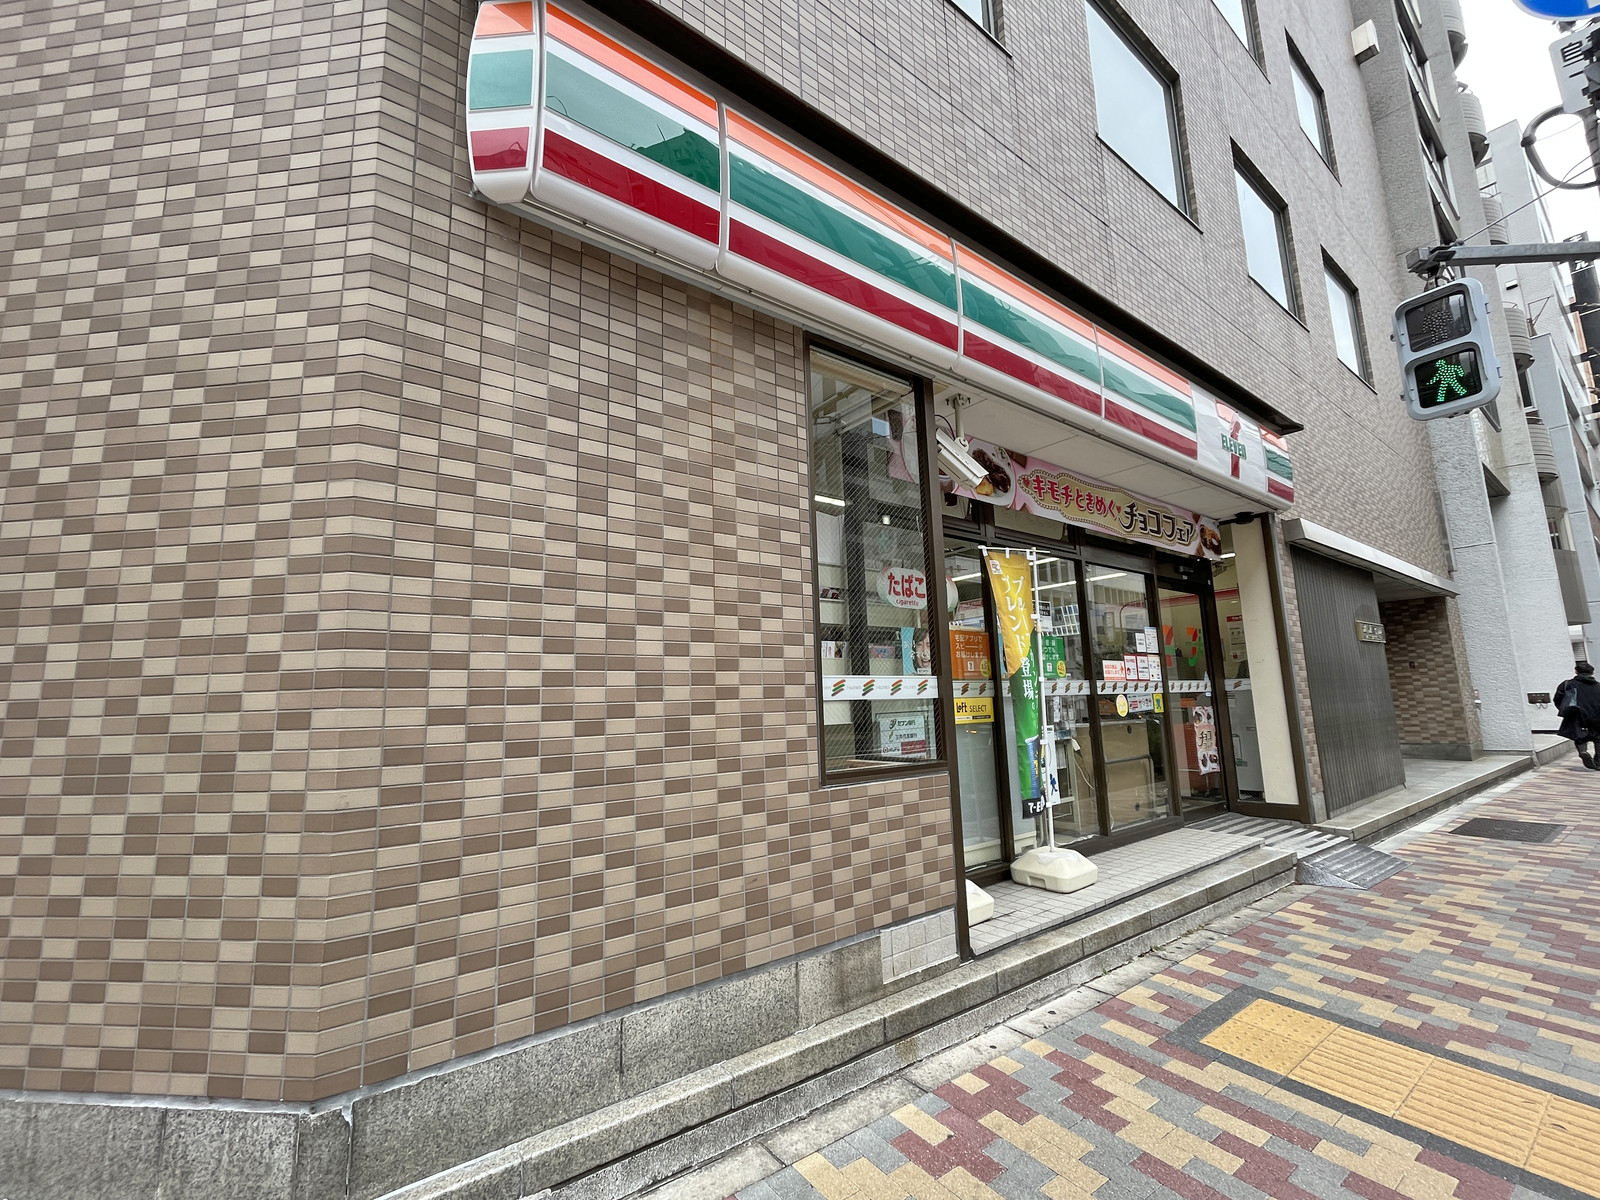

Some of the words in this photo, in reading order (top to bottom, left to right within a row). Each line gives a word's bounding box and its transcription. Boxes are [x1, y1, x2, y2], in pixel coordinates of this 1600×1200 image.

[1033, 473, 1115, 518] キモチときめく
[1117, 501, 1196, 543] チョコフェア
[887, 572, 926, 598] たばこ
[969, 704, 987, 713] SELECT
